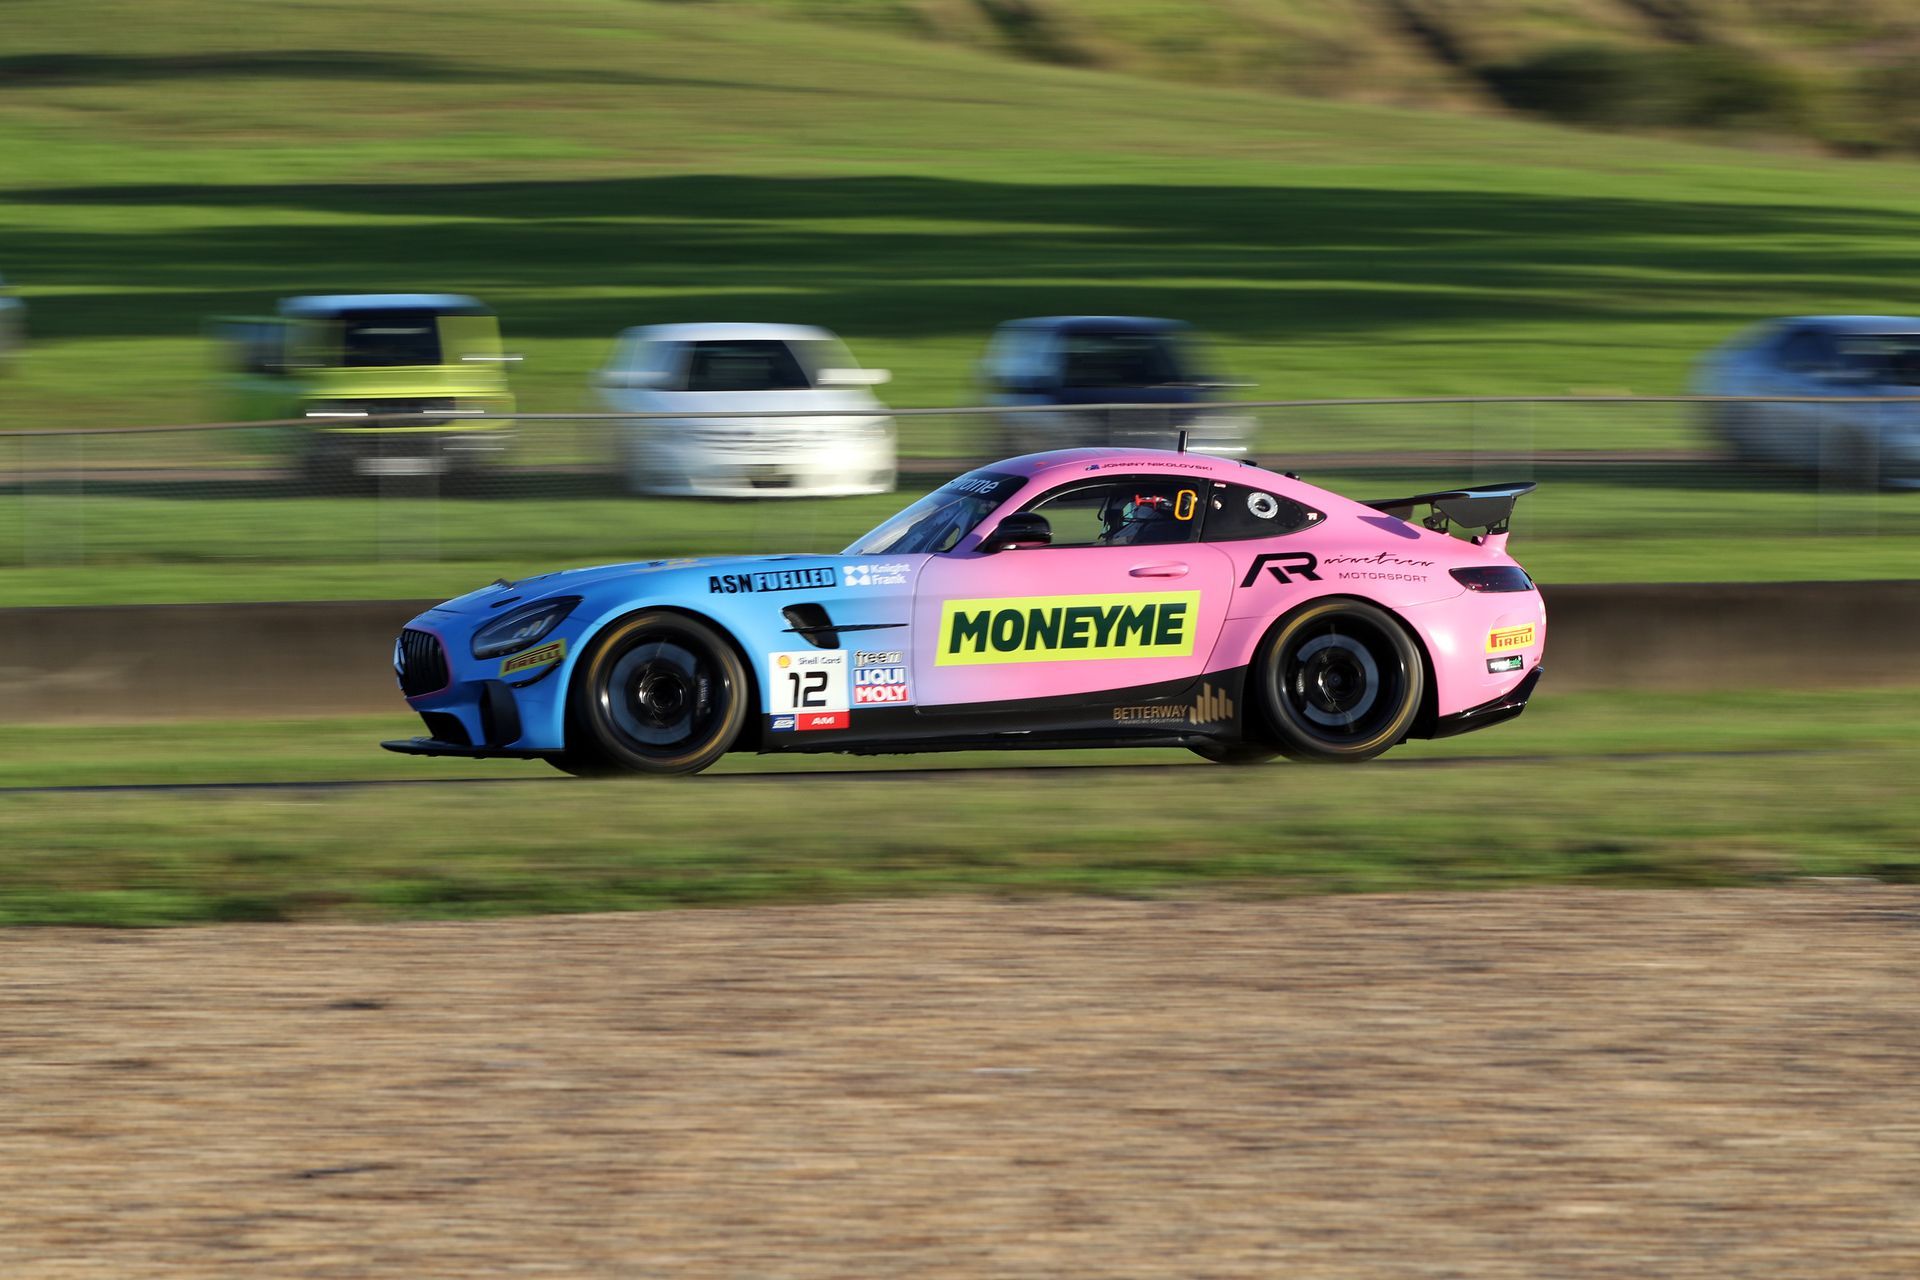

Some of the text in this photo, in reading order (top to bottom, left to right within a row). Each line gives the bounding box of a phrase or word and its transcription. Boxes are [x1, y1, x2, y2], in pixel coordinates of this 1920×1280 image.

[1101, 461, 1146, 470] JOHNNY
[870, 563, 912, 575] Knight
[1339, 571, 1429, 583] MOTORSPORT
[708, 567, 837, 594] ASN FUELLED
[871, 573, 907, 586] Frank
[948, 602, 1188, 655] MONEYME
[1490, 627, 1533, 649] PIRELLI
[504, 643, 562, 673] PIRELLI
[799, 656, 818, 665] Shell
[854, 668, 905, 686] LIQUI
[788, 671, 829, 708] 12
[855, 685, 907, 703] MOLY
[1113, 705, 1188, 720] BETTERWAY
